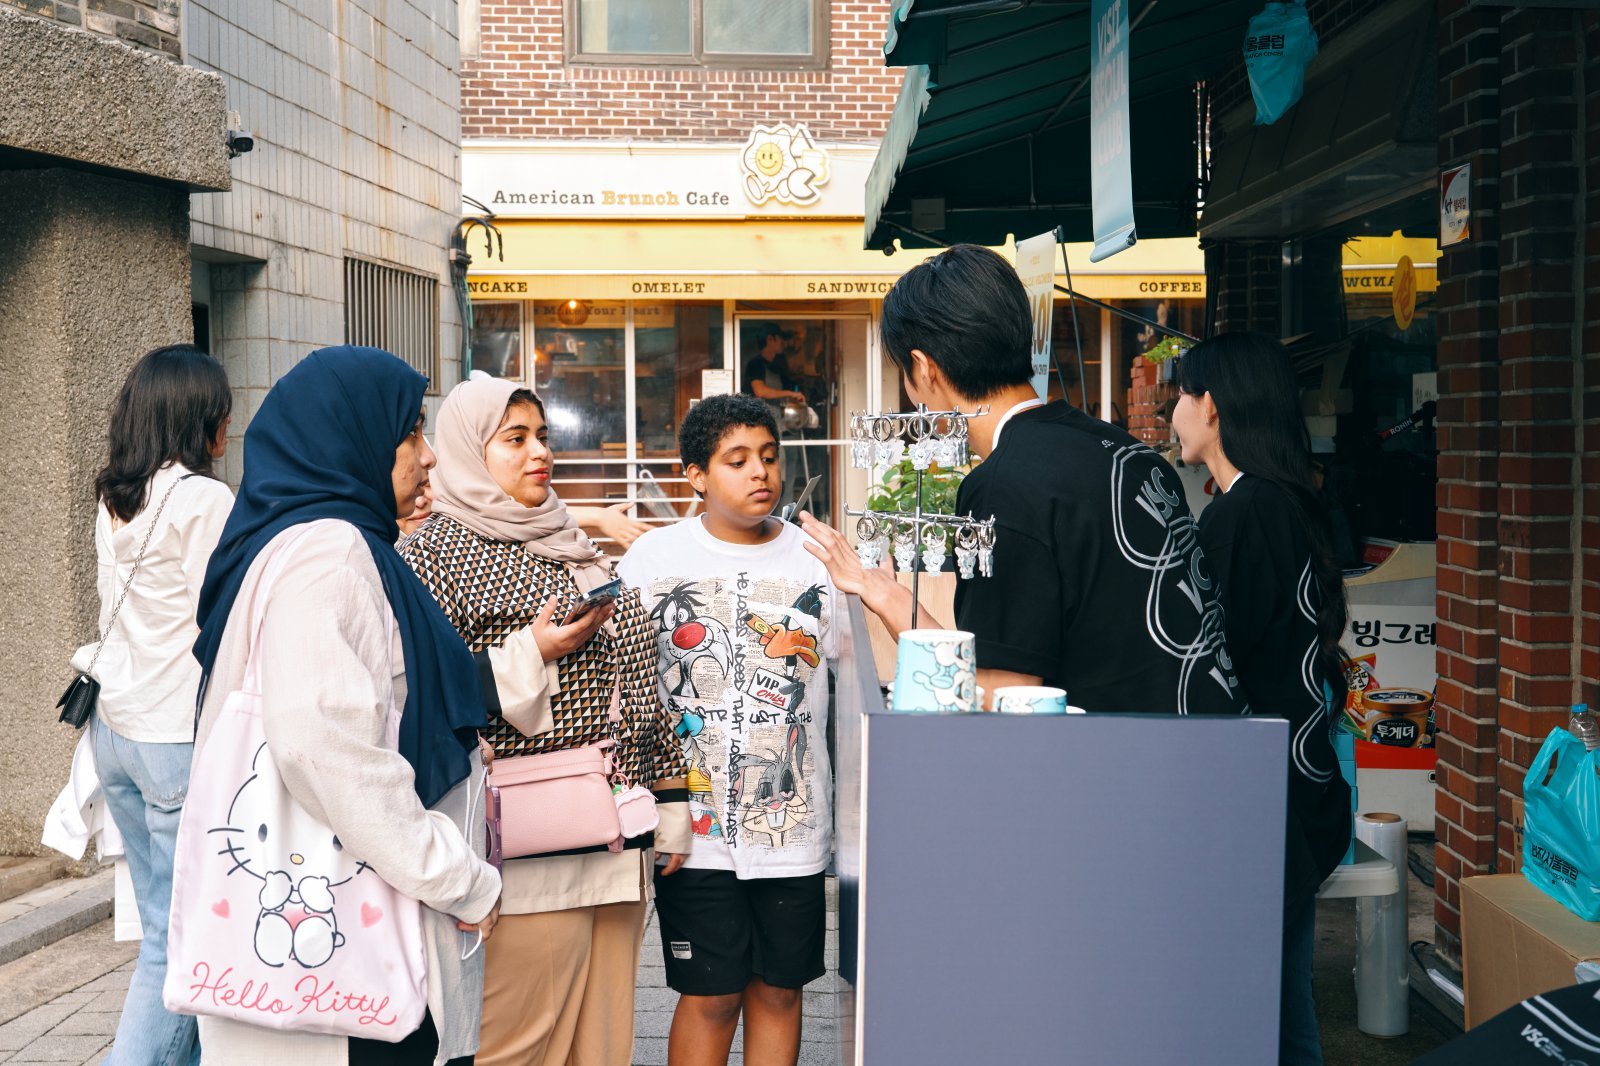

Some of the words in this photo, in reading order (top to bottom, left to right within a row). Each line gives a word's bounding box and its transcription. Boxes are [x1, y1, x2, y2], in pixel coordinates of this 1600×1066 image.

[492, 190, 595, 205] American
[601, 190, 680, 206] Brunch
[686, 191, 730, 206] Cafe
[467, 282, 528, 293] NCAKE
[632, 282, 706, 293] OMELET
[1139, 281, 1202, 293] COFFEE
[1390, 417, 1413, 436] RONIN
[1135, 467, 1179, 529] VSC
[756, 673, 779, 690] VIP
[731, 696, 744, 734] THAT
[1376, 724, 1414, 740] 투게더
[726, 812, 738, 849] LAST
[190, 960, 293, 1014] Hello
[295, 974, 398, 1025] Kitty
[1520, 1023, 1550, 1049] VSC
